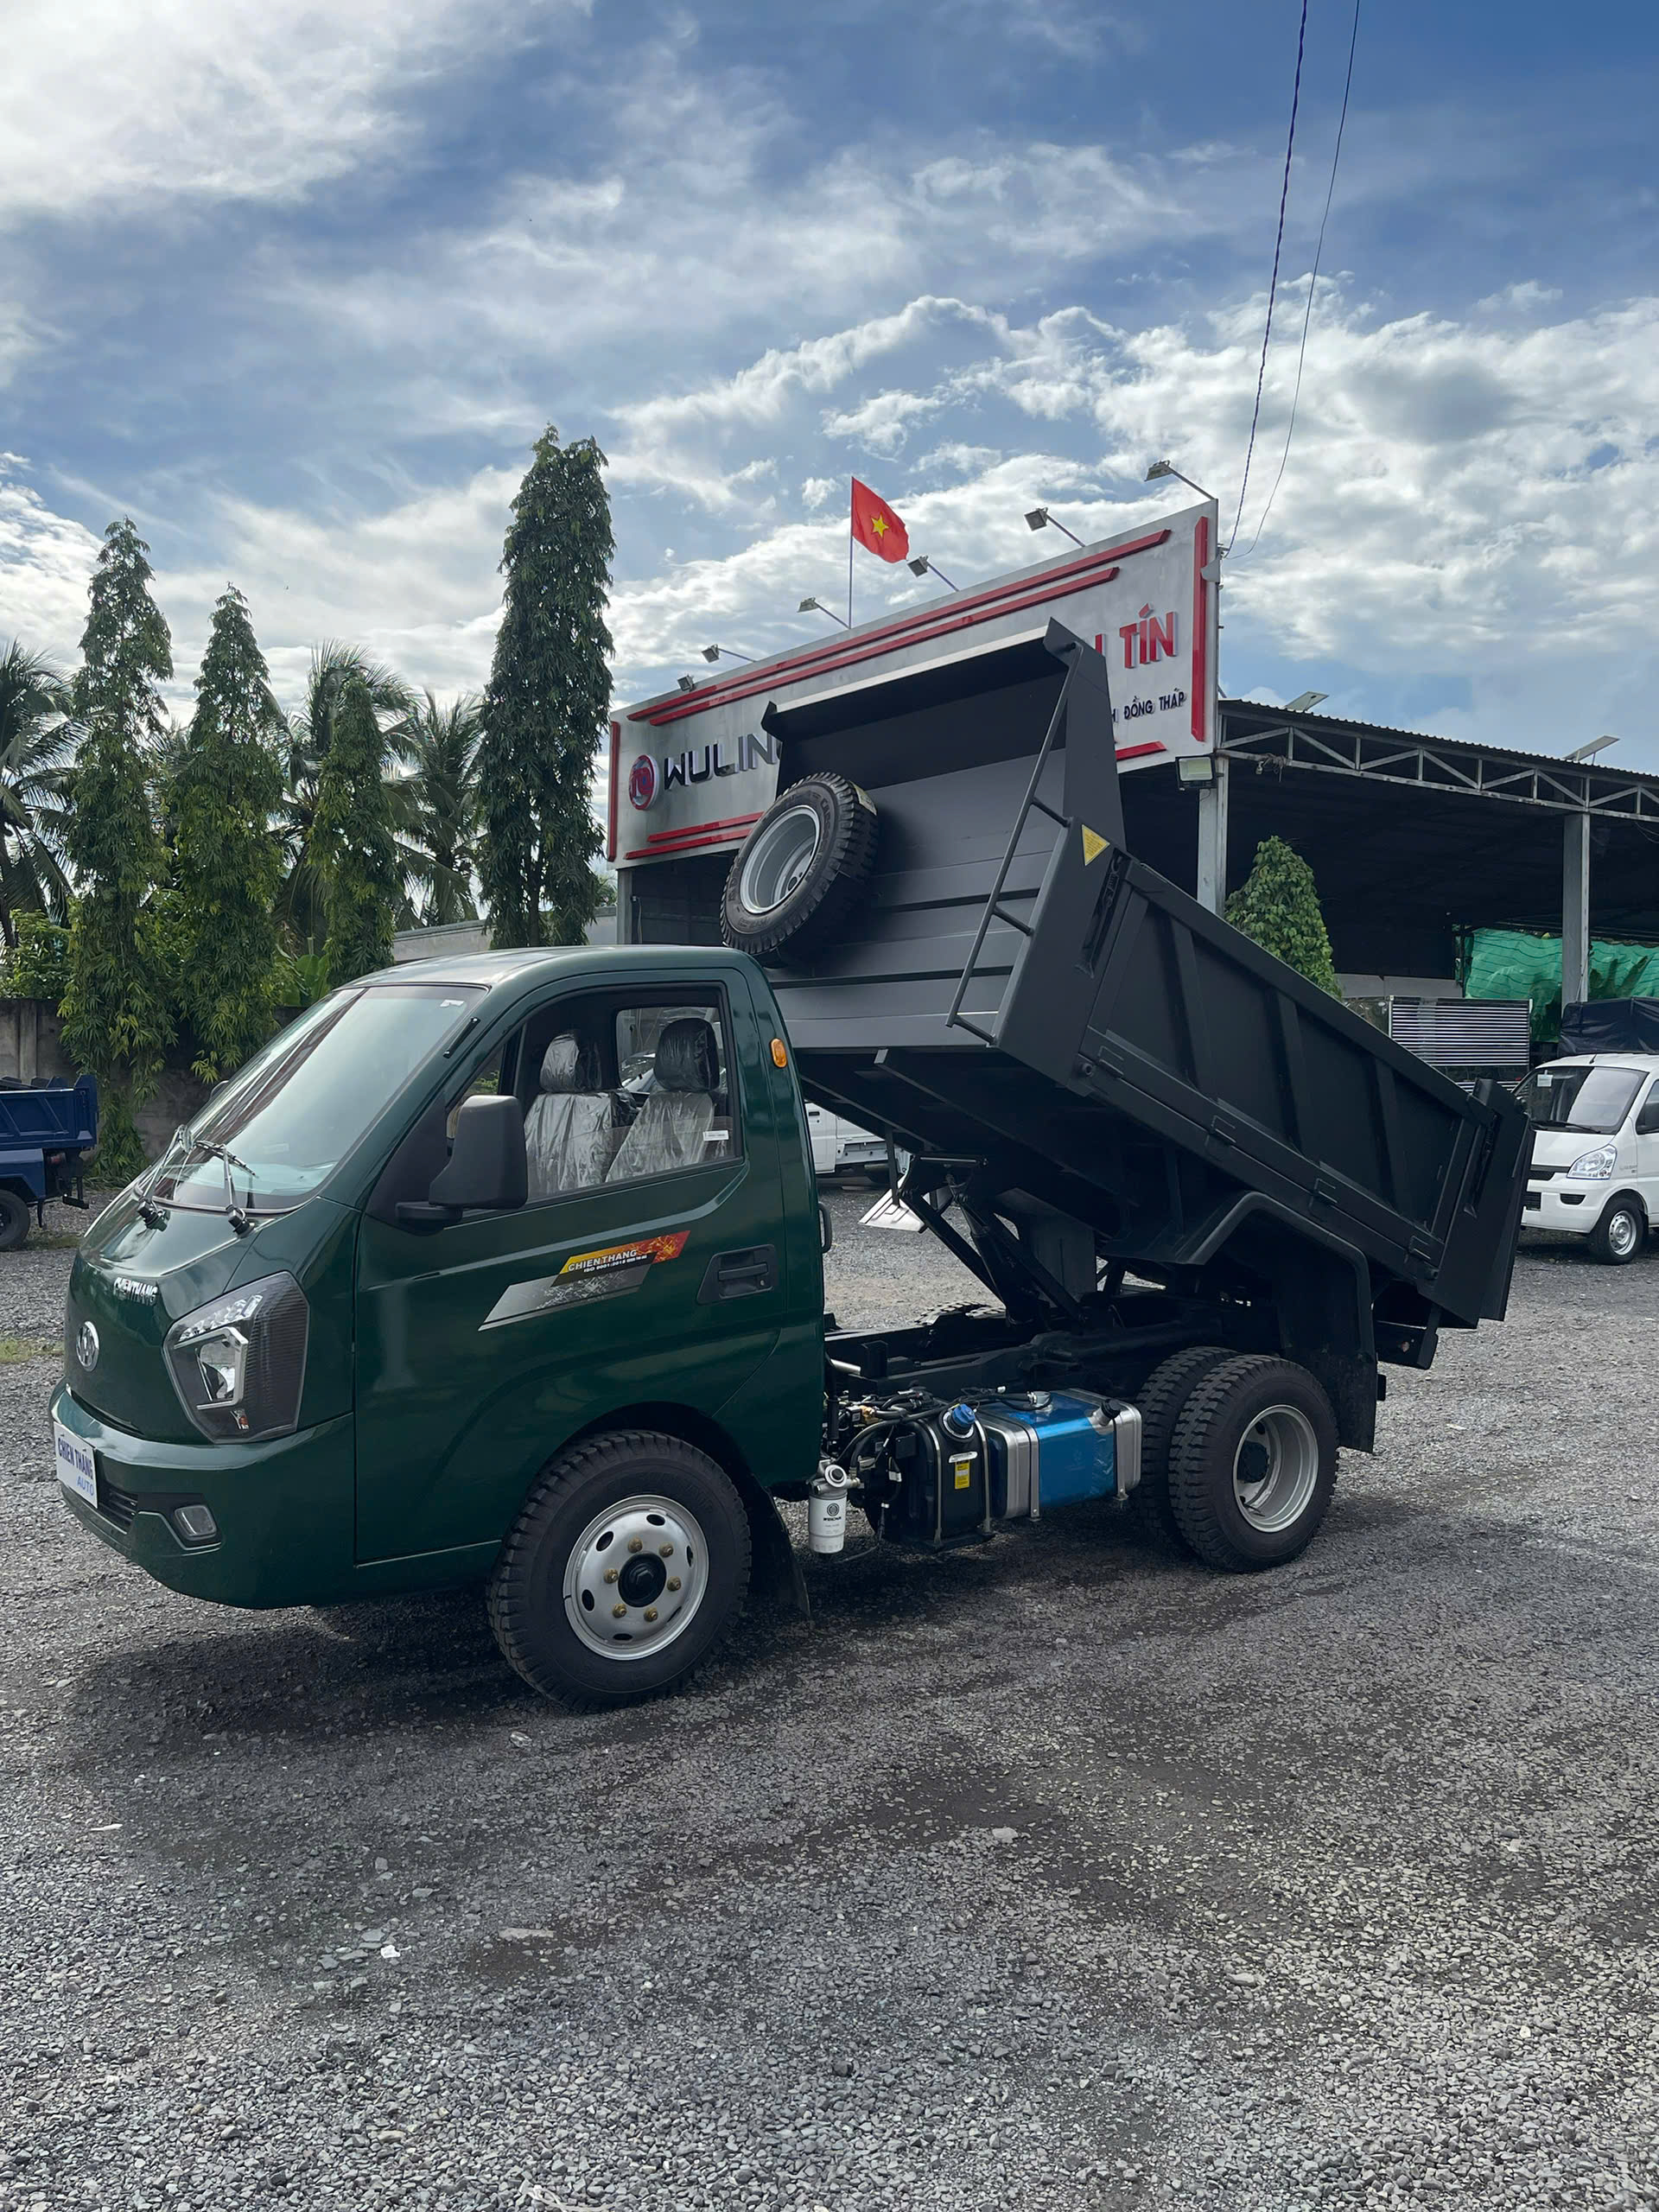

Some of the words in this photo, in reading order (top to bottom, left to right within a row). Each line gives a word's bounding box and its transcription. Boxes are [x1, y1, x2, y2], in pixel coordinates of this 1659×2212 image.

[1120, 603, 1177, 669] TÍN
[1124, 696, 1154, 720] ĐỒNG
[1159, 688, 1187, 710] THẤP
[664, 734, 782, 790] WULIN
[77, 1476, 94, 1496] AUTO
